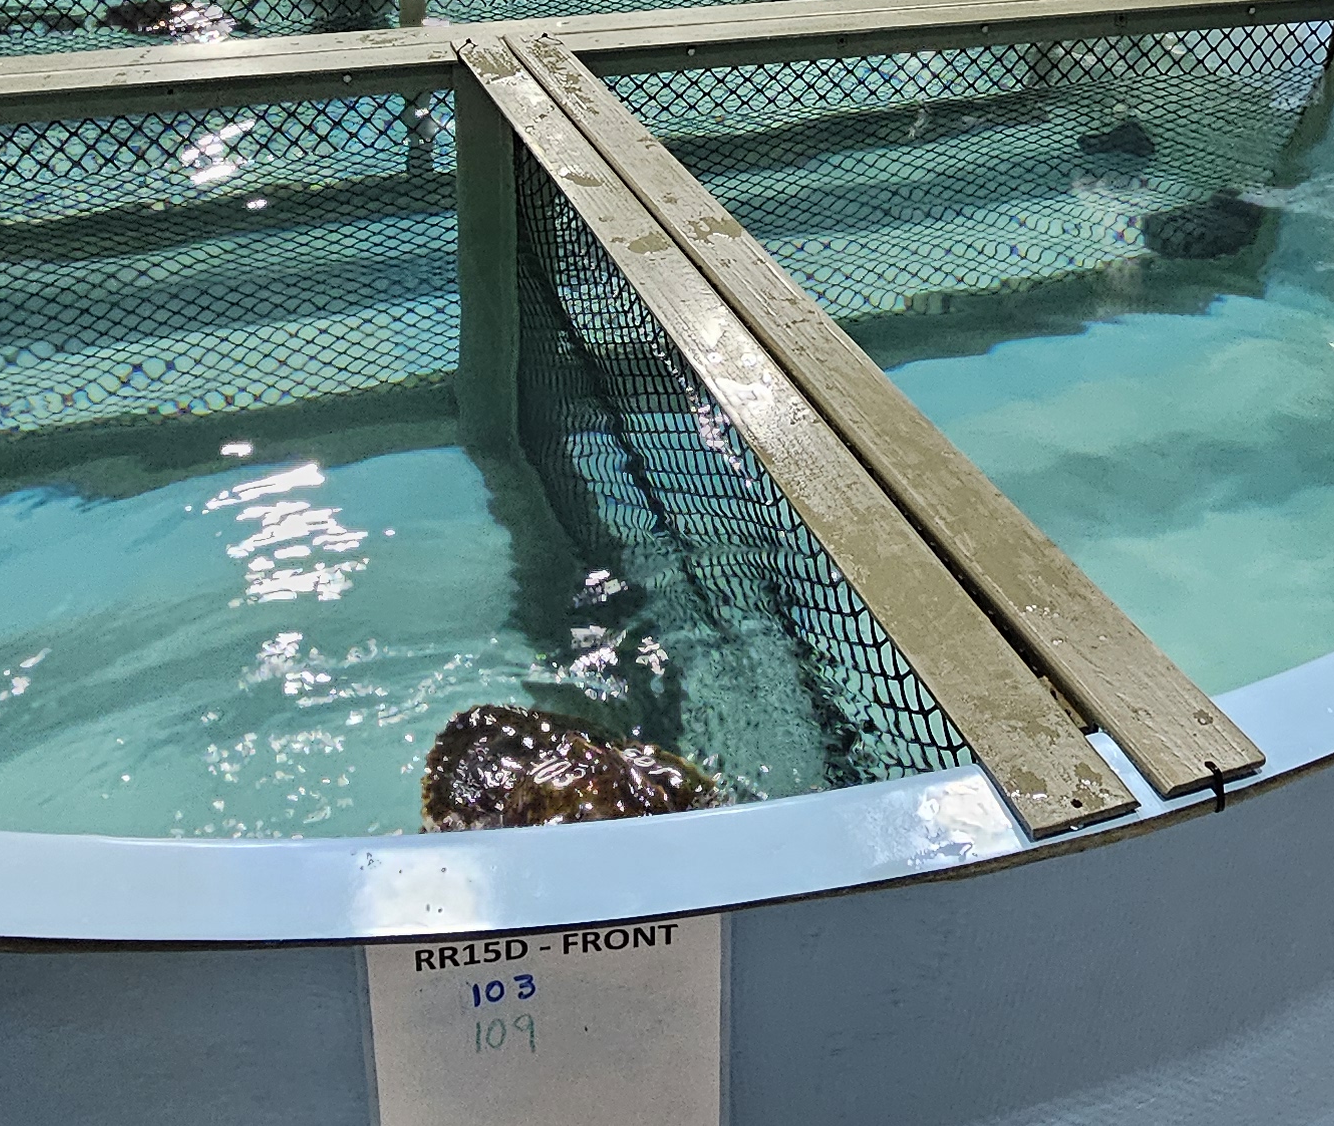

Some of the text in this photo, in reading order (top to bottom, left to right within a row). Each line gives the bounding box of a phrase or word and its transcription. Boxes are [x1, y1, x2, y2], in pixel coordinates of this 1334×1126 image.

[415, 938, 529, 972] RR15D
[563, 923, 679, 955] FRONT
[472, 973, 536, 1007] 103
[475, 1013, 536, 1053] 109
